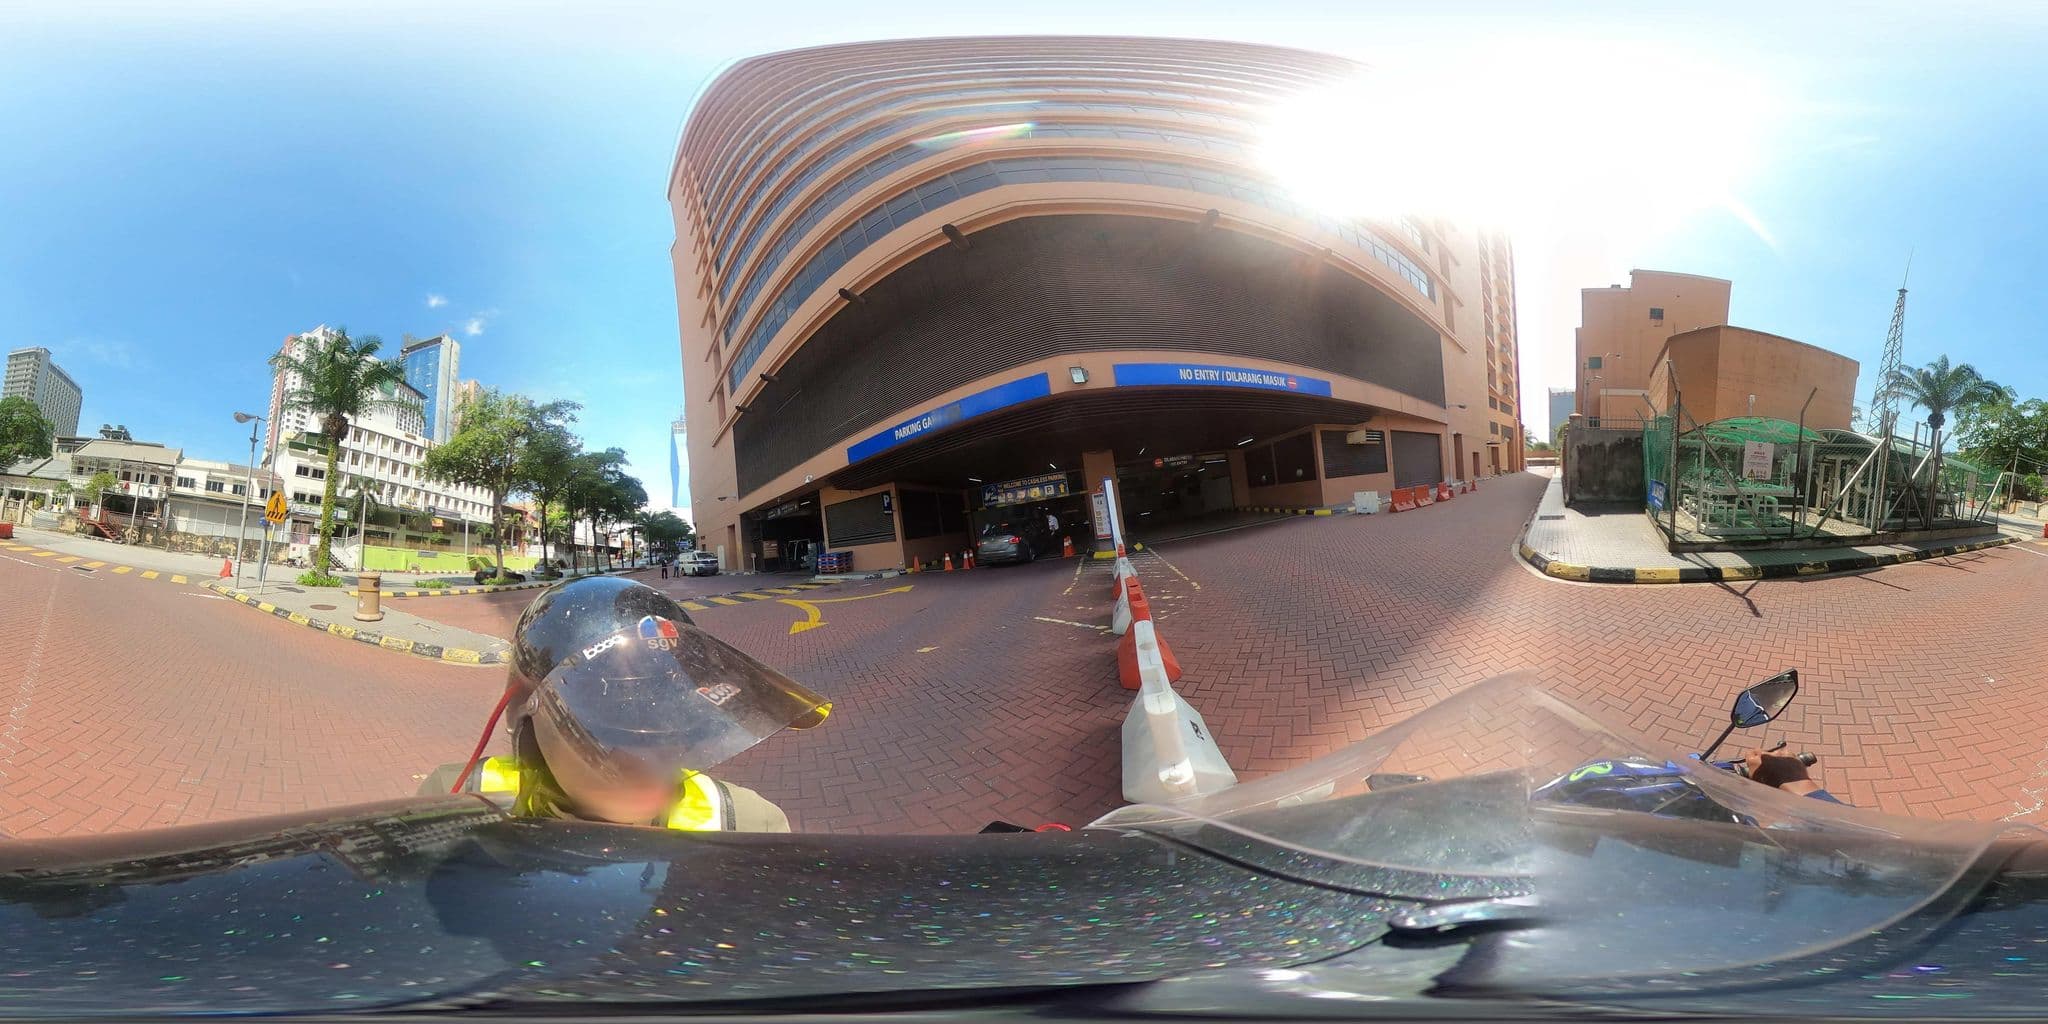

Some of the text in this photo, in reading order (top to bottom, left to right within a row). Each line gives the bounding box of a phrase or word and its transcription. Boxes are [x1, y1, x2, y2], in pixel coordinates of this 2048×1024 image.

[1179, 369, 1193, 381] NO
[1194, 369, 1220, 382] ENTRY
[1225, 371, 1262, 385] DILARANG
[1263, 374, 1287, 388] MASUK
[894, 420, 922, 441] PARKING
[883, 495, 890, 507] P
[648, 638, 678, 651] sgv
